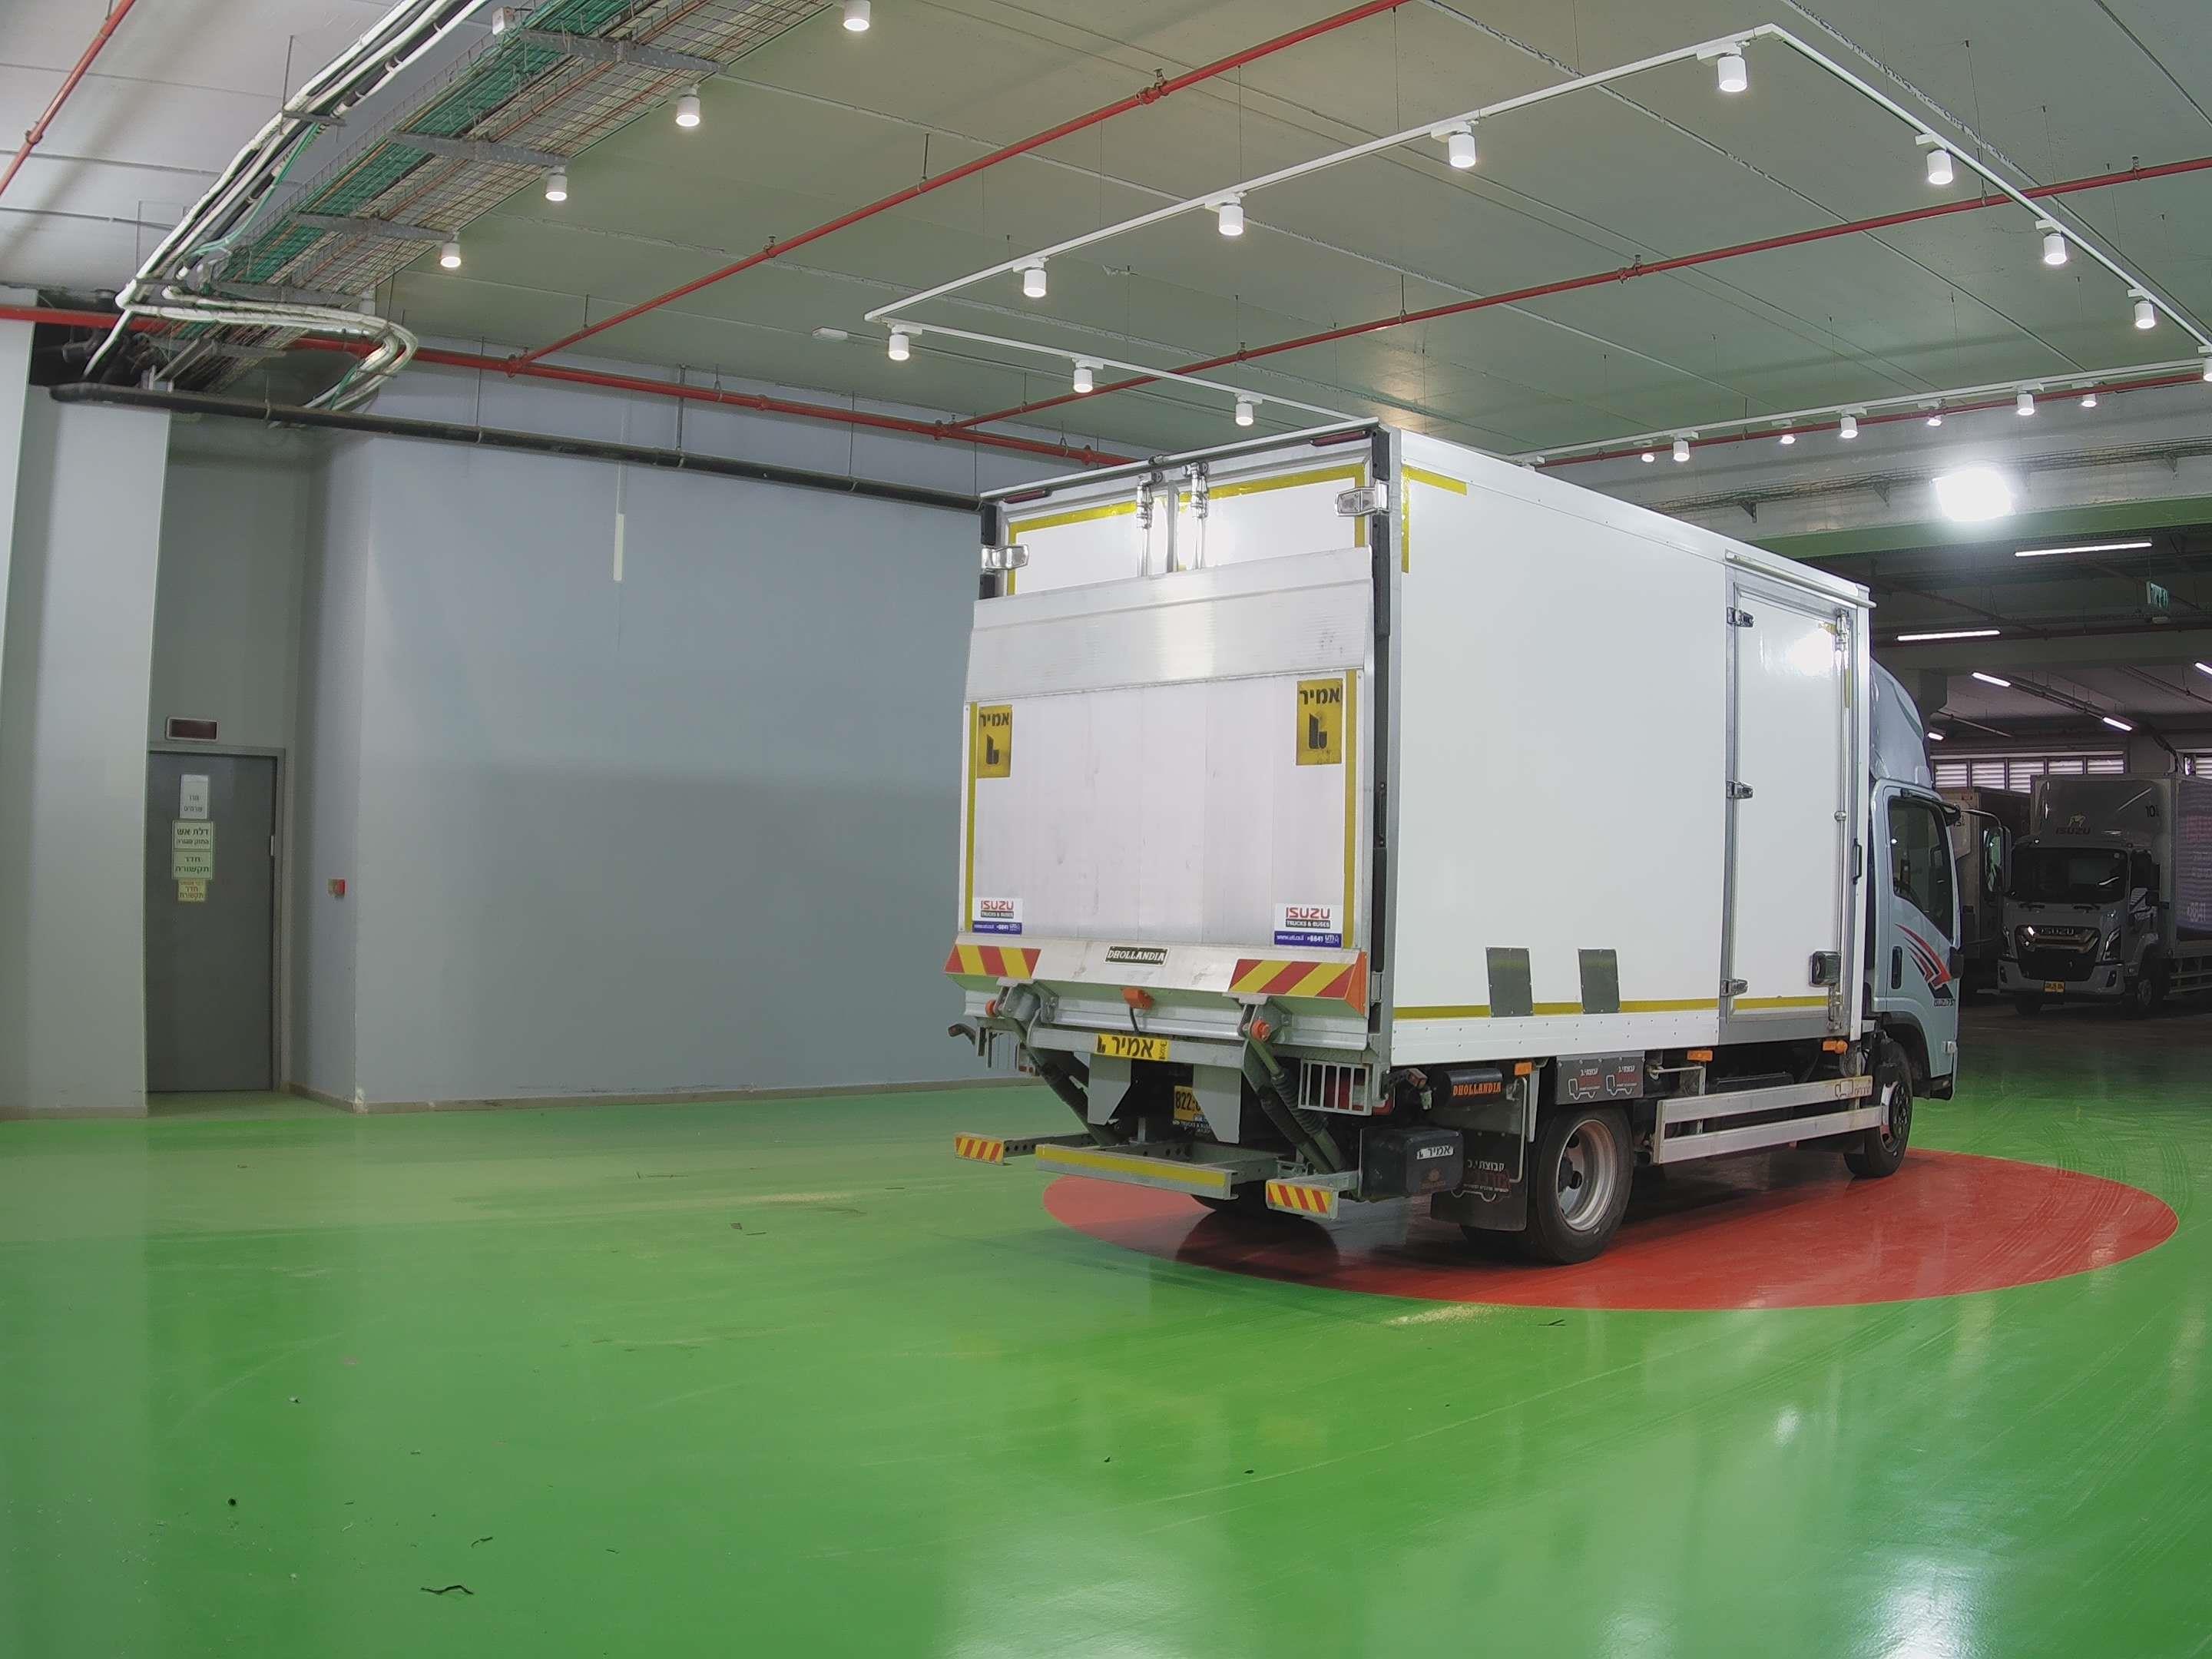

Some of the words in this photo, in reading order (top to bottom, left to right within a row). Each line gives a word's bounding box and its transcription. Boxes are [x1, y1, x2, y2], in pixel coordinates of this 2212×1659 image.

[1300, 688, 1339, 704] אמיר
[980, 713, 1009, 727] אמיר
[981, 900, 1014, 910] ISUZU
[1286, 907, 1330, 919] ISUZU
[1108, 950, 1165, 962] DHOLLANDIA
[1111, 1036, 1154, 1058] אמיר
[1452, 1081, 1502, 1096] DHOLLANDIA
[1429, 1146, 1451, 1157] אמיר
